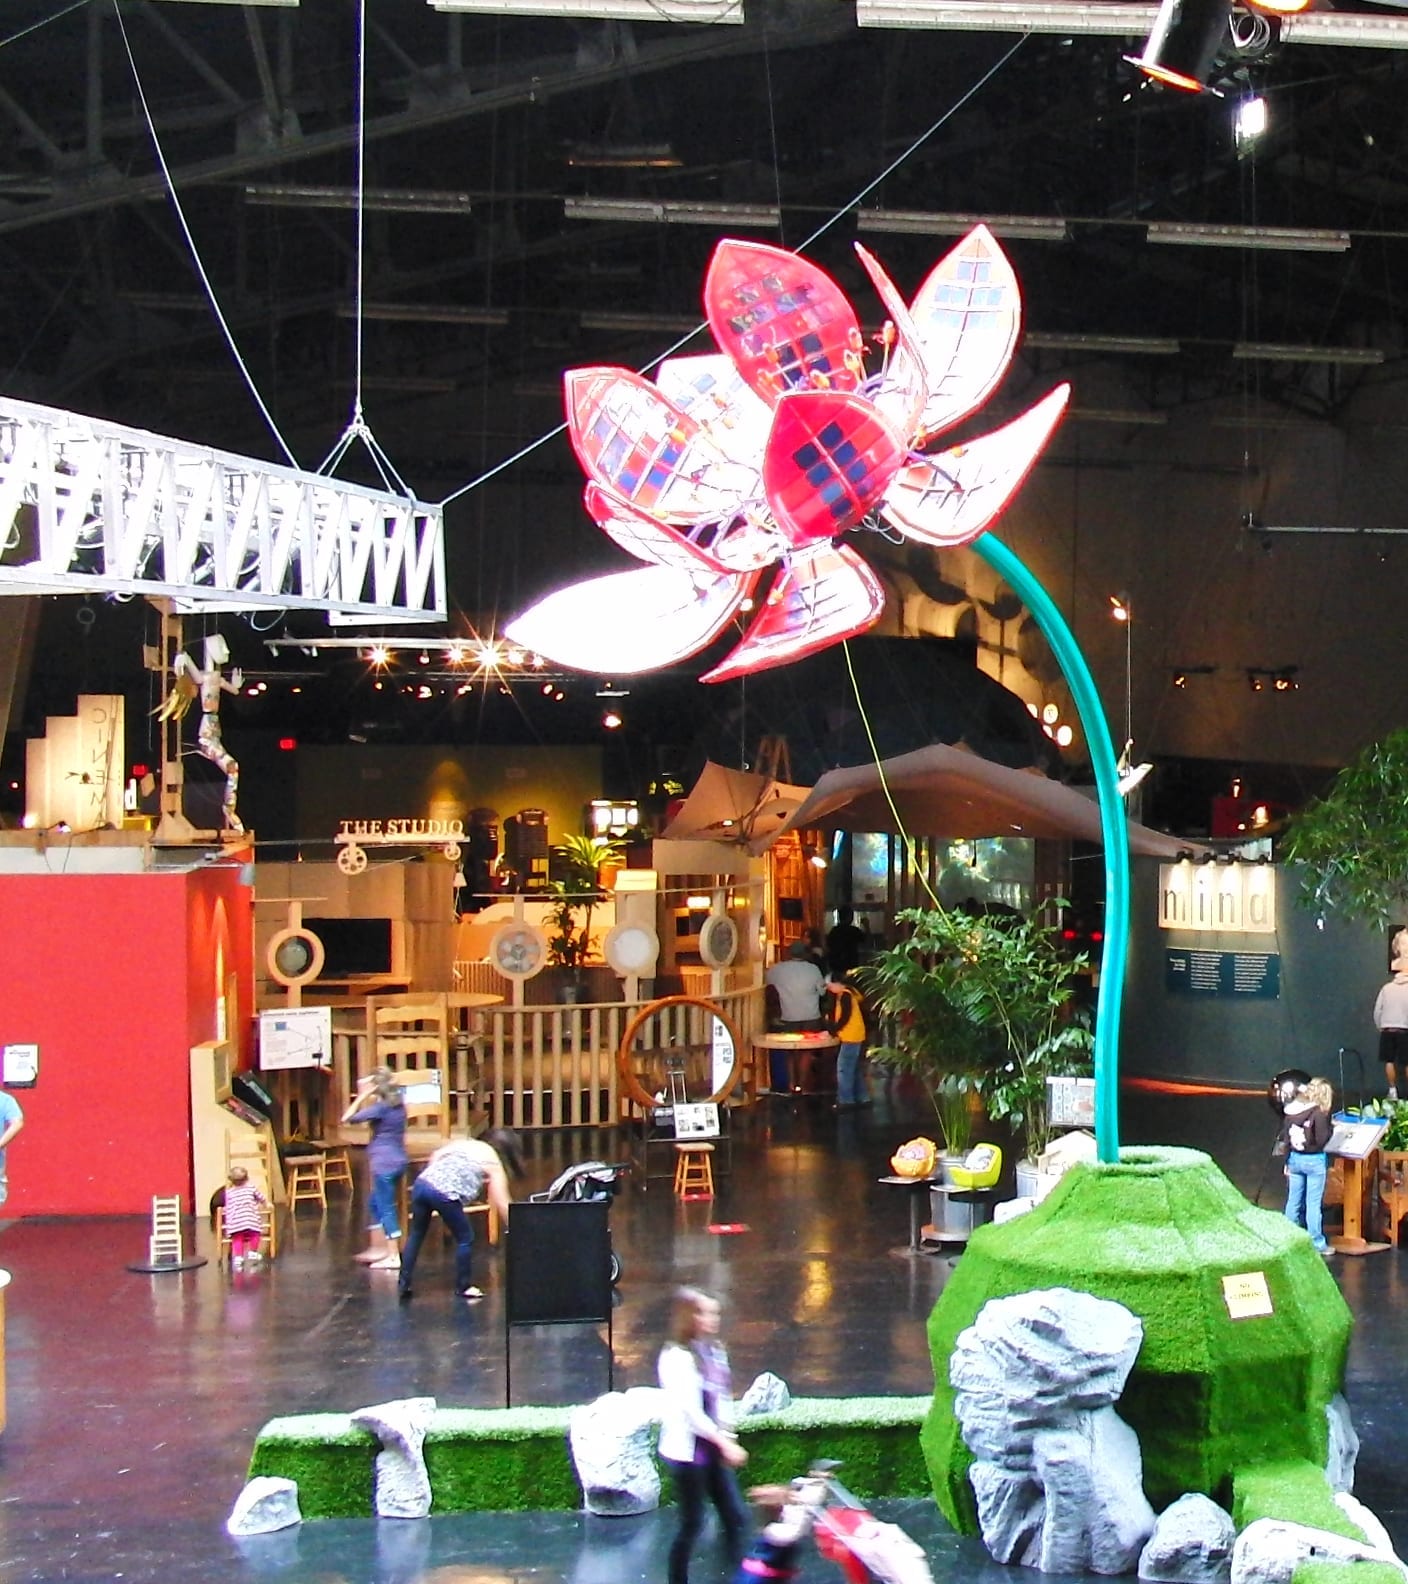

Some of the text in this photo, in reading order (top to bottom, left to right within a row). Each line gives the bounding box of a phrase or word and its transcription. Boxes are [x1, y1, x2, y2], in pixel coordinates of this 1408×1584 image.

[340, 819, 464, 835] THE STUDIO
[1164, 878, 1268, 924] mind
